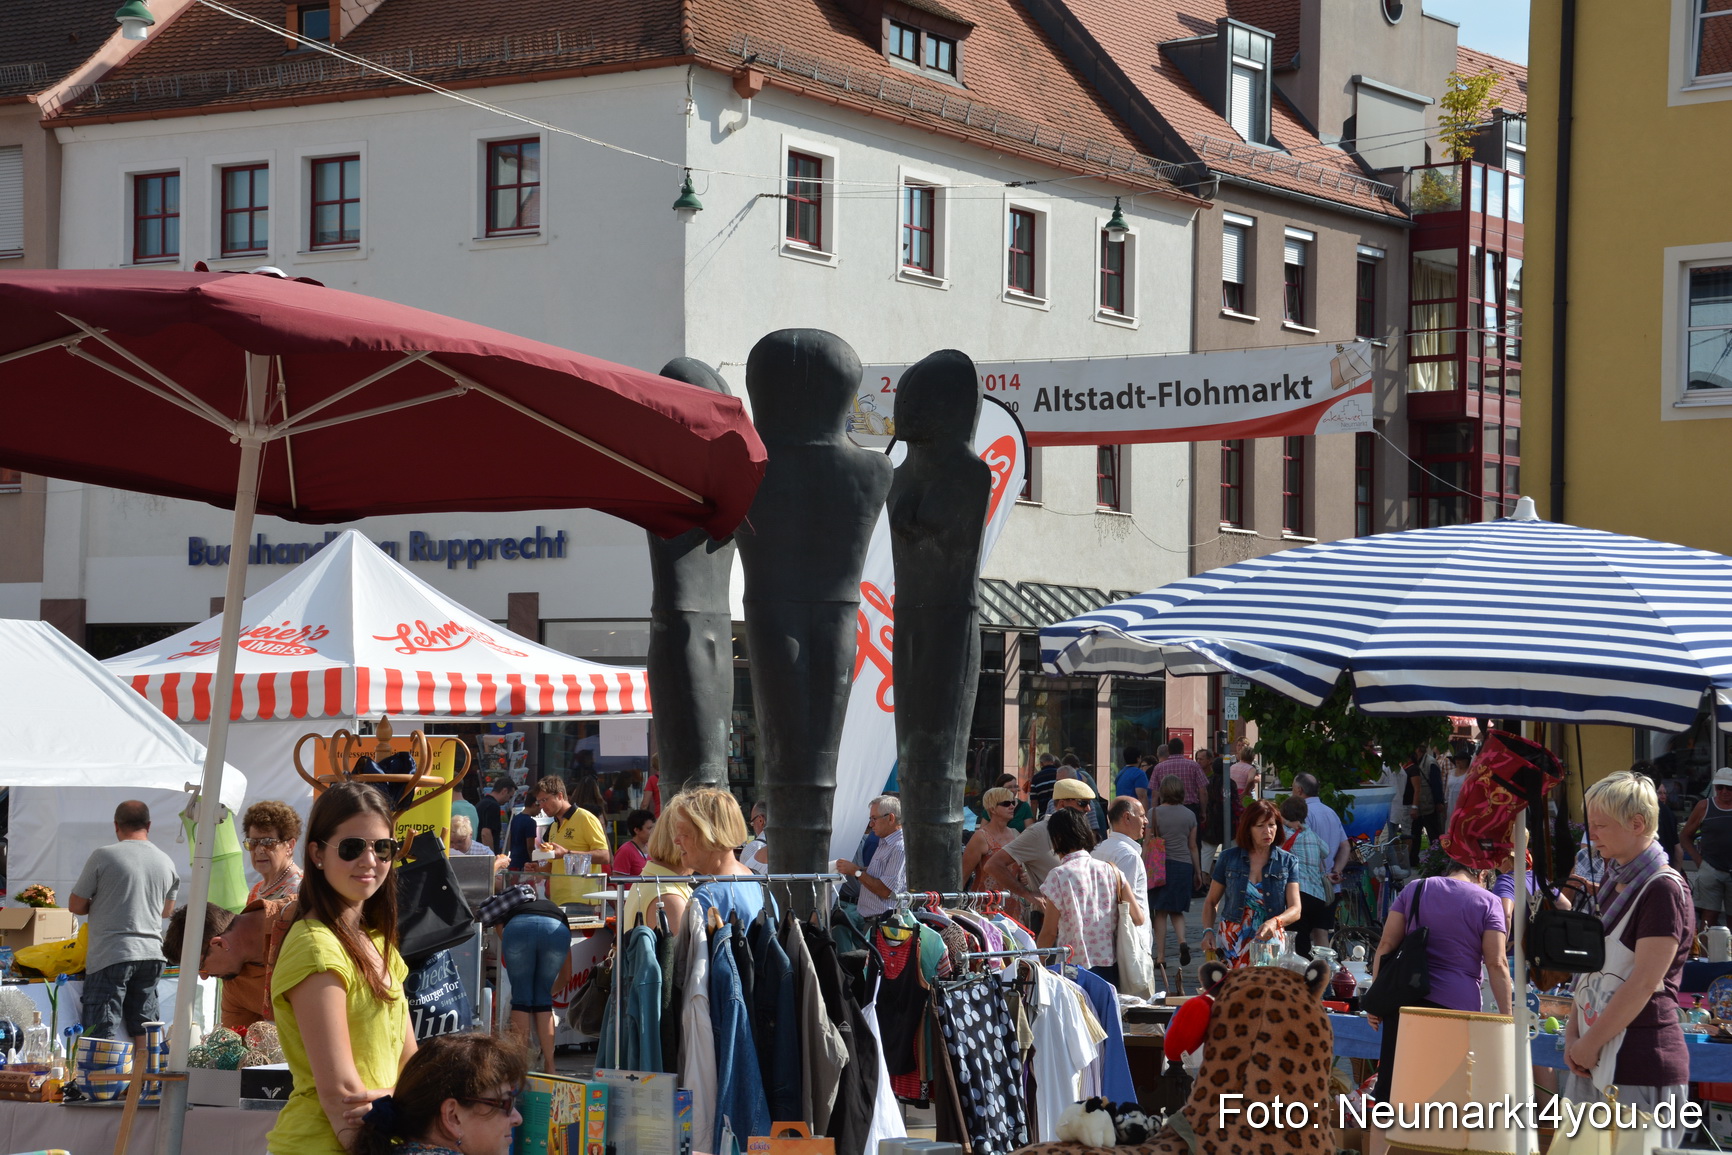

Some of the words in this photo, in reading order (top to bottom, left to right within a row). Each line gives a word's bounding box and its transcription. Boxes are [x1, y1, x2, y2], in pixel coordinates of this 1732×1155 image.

[981, 373, 1021, 392] 014
[1033, 373, 1313, 412] Altstadt-Flohmarkt
[409, 525, 567, 569] Rupprecht
[245, 640, 306, 656] IMBISS
[443, 980, 460, 993] Tor
